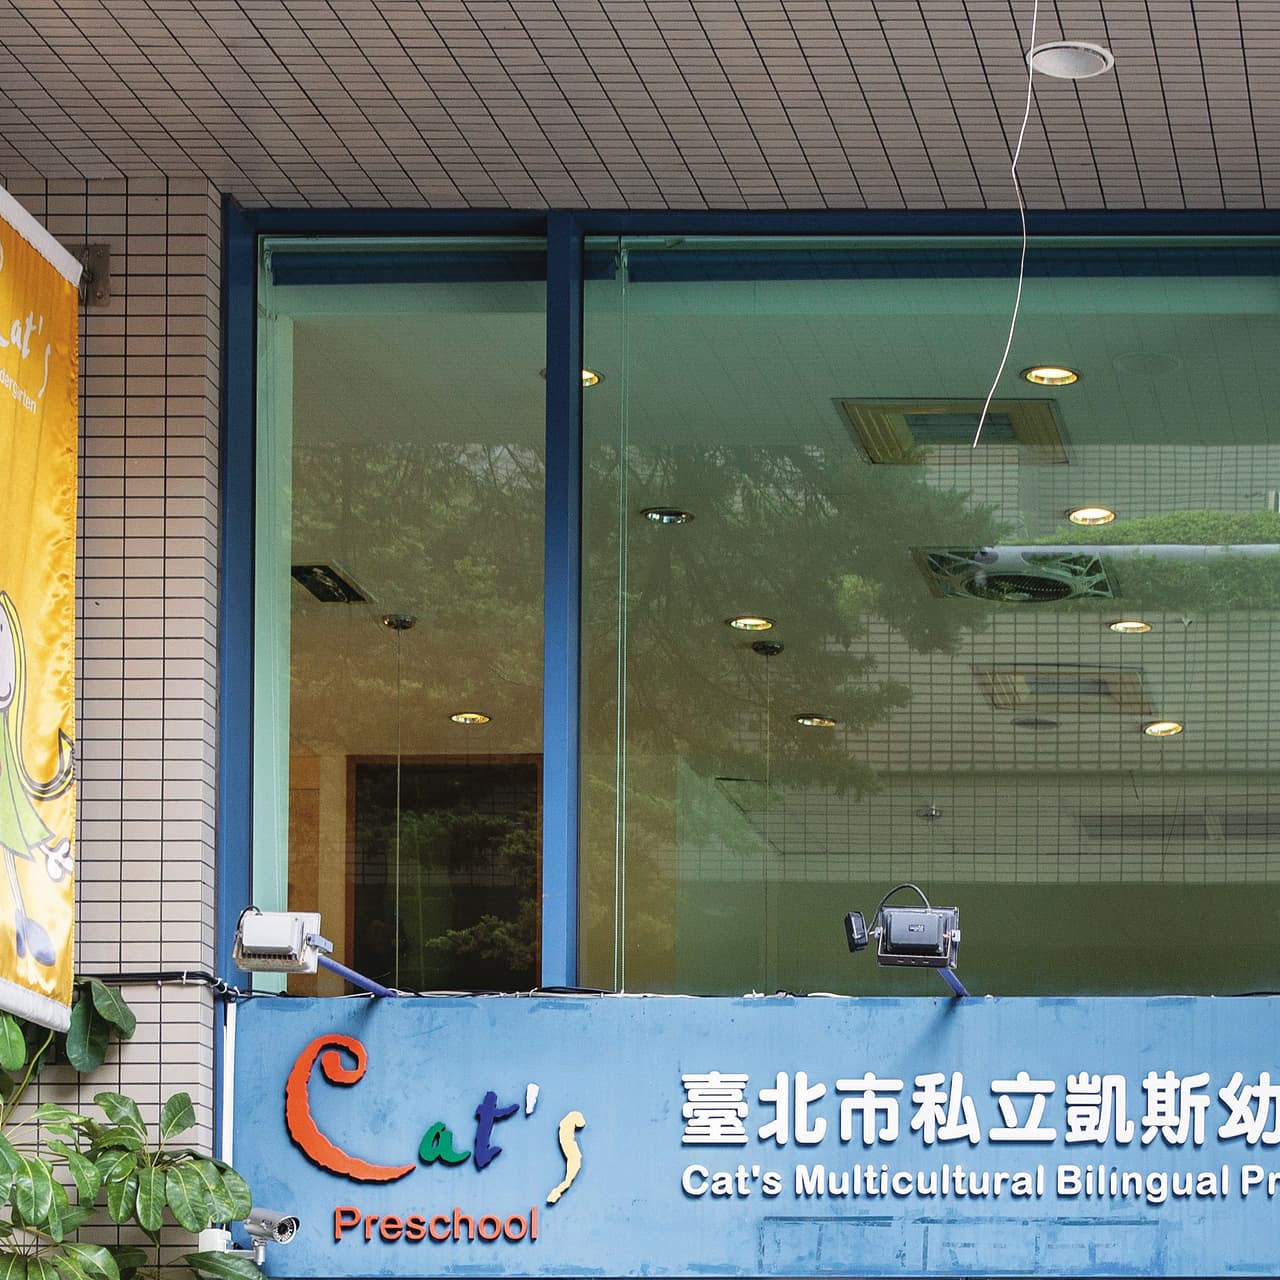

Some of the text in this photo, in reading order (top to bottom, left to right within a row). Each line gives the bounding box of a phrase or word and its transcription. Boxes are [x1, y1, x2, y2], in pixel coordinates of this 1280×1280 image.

[285, 1033, 587, 1206] Cat's
[681, 1163, 783, 1197] Cat's
[794, 1163, 1045, 1197] Multicultural
[1056, 1164, 1230, 1204] Bilingual
[332, 1205, 539, 1243] Preschool
